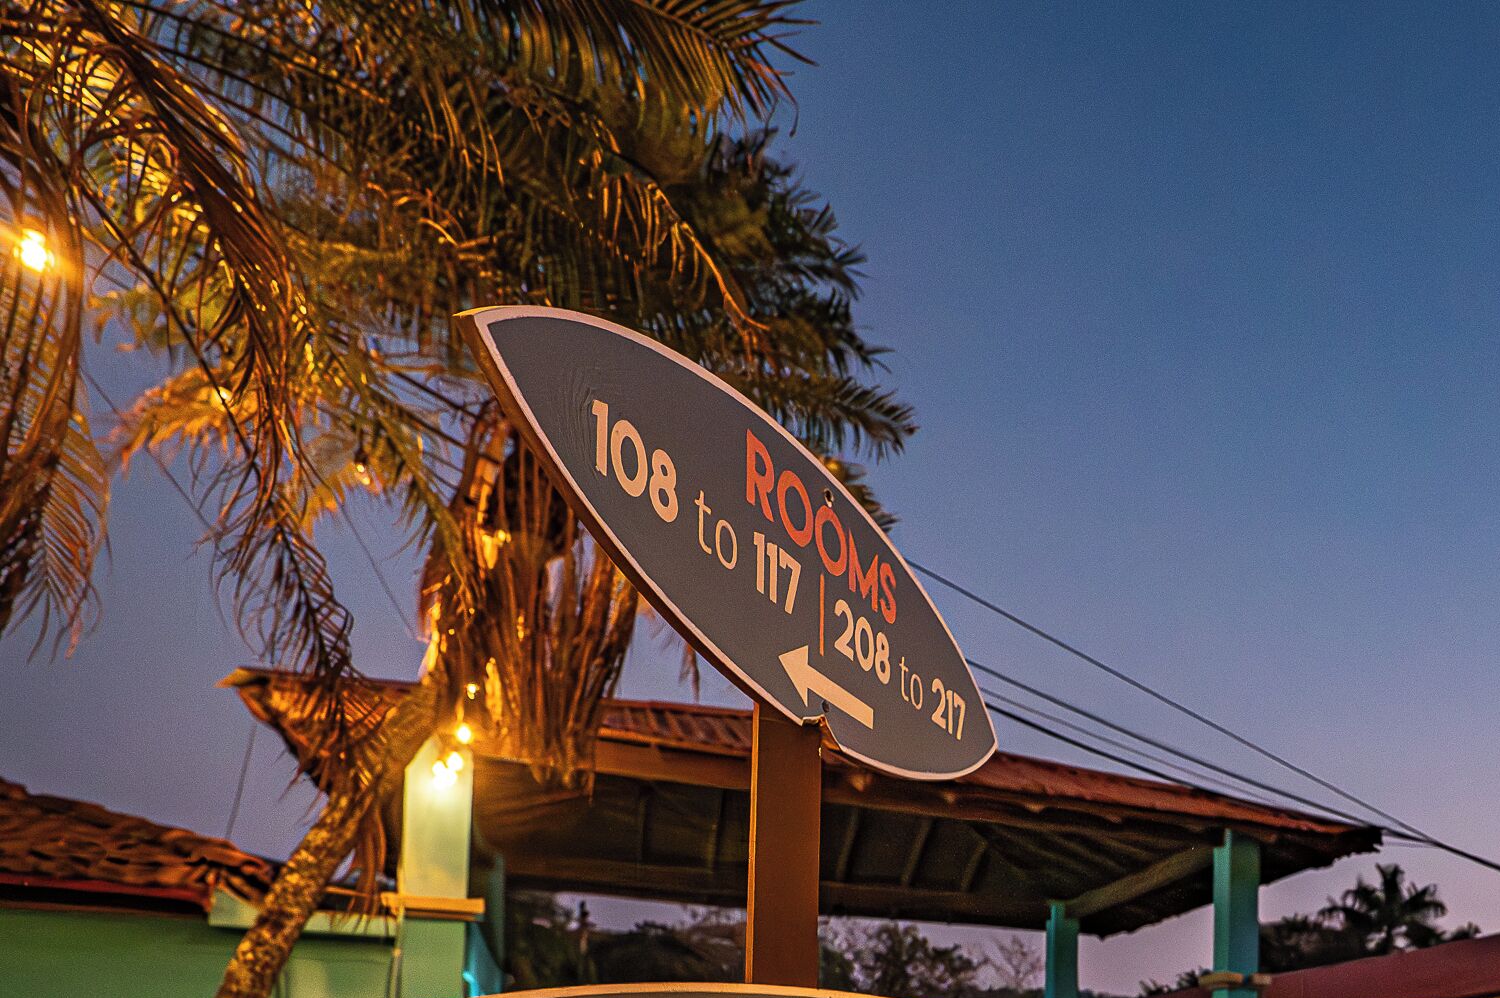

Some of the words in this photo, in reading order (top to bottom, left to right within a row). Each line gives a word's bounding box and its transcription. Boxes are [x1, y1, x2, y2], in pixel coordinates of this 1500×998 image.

[592, 398, 679, 523] 108
[694, 490, 738, 570] to
[753, 531, 801, 614] 117
[834, 599, 891, 684] 208
[899, 656, 923, 710] to
[931, 677, 966, 740] 217
[745, 429, 897, 624] ROOMS
